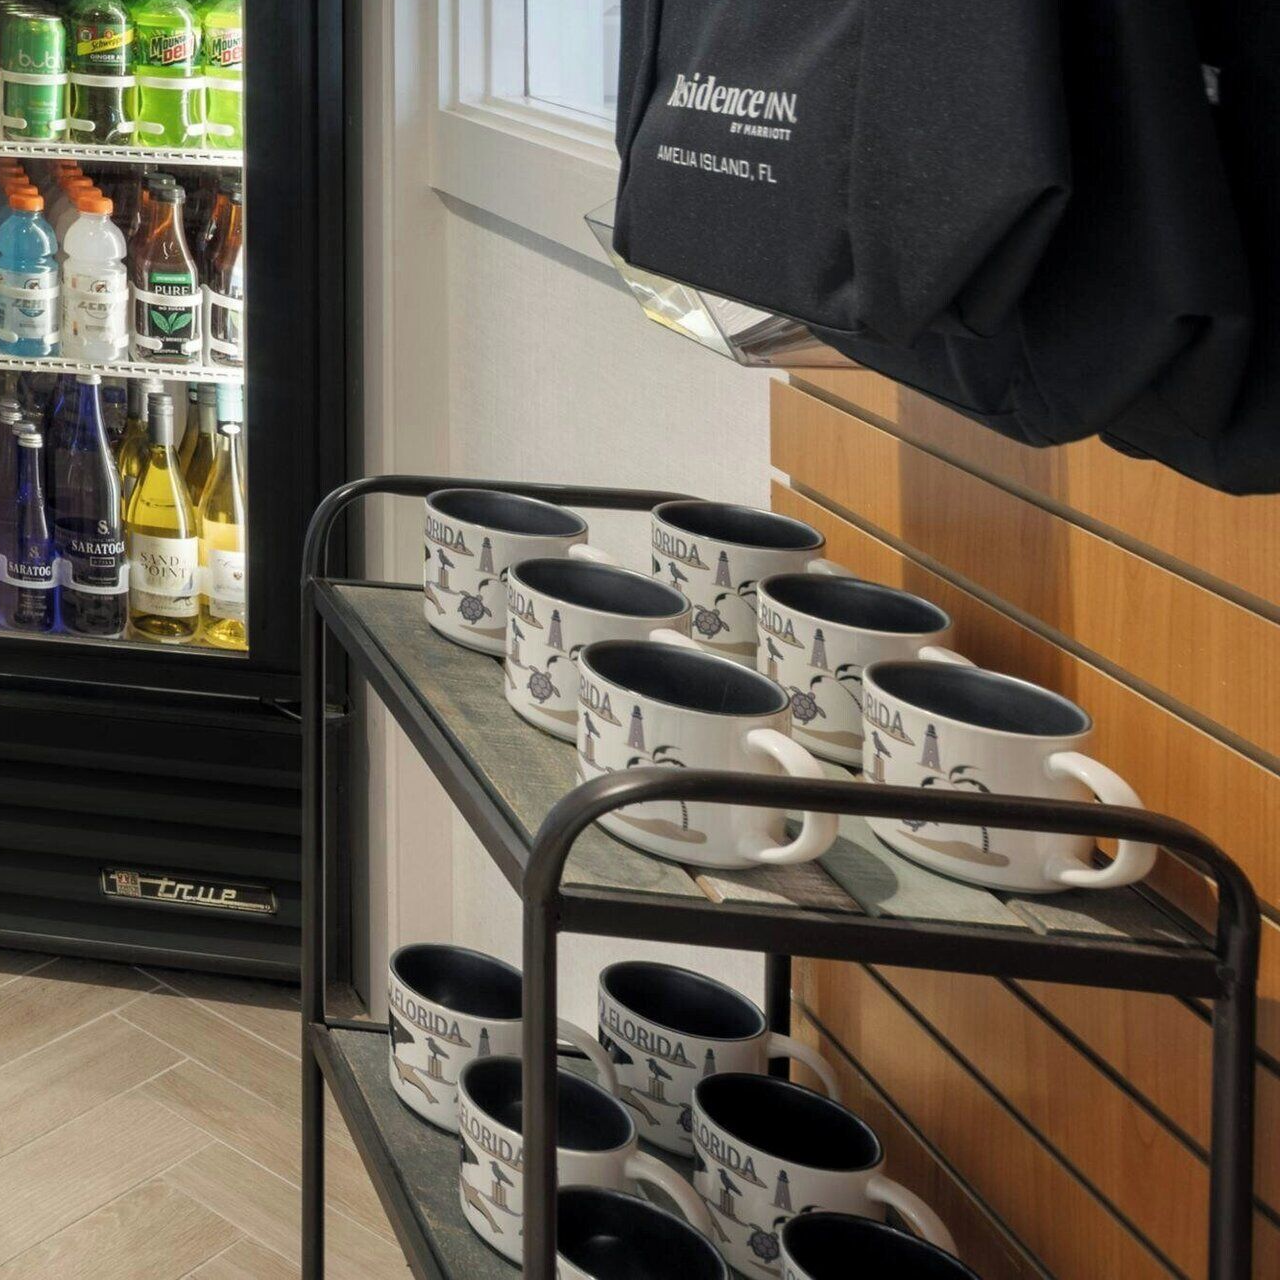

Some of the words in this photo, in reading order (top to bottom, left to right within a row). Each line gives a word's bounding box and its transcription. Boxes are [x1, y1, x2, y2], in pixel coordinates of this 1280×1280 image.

[730, 122, 742, 134] BY
[743, 124, 792, 141] MARRIOTT
[657, 144, 697, 168] AMELIA
[700, 153, 755, 182] ISLAND,
[759, 163, 777, 184] FL
[154, 285, 189, 296] PURE
[71, 539, 125, 555] SARATOGA
[394, 987, 463, 1042] FLORIDA
[609, 1009, 687, 1063] FLORIDA
